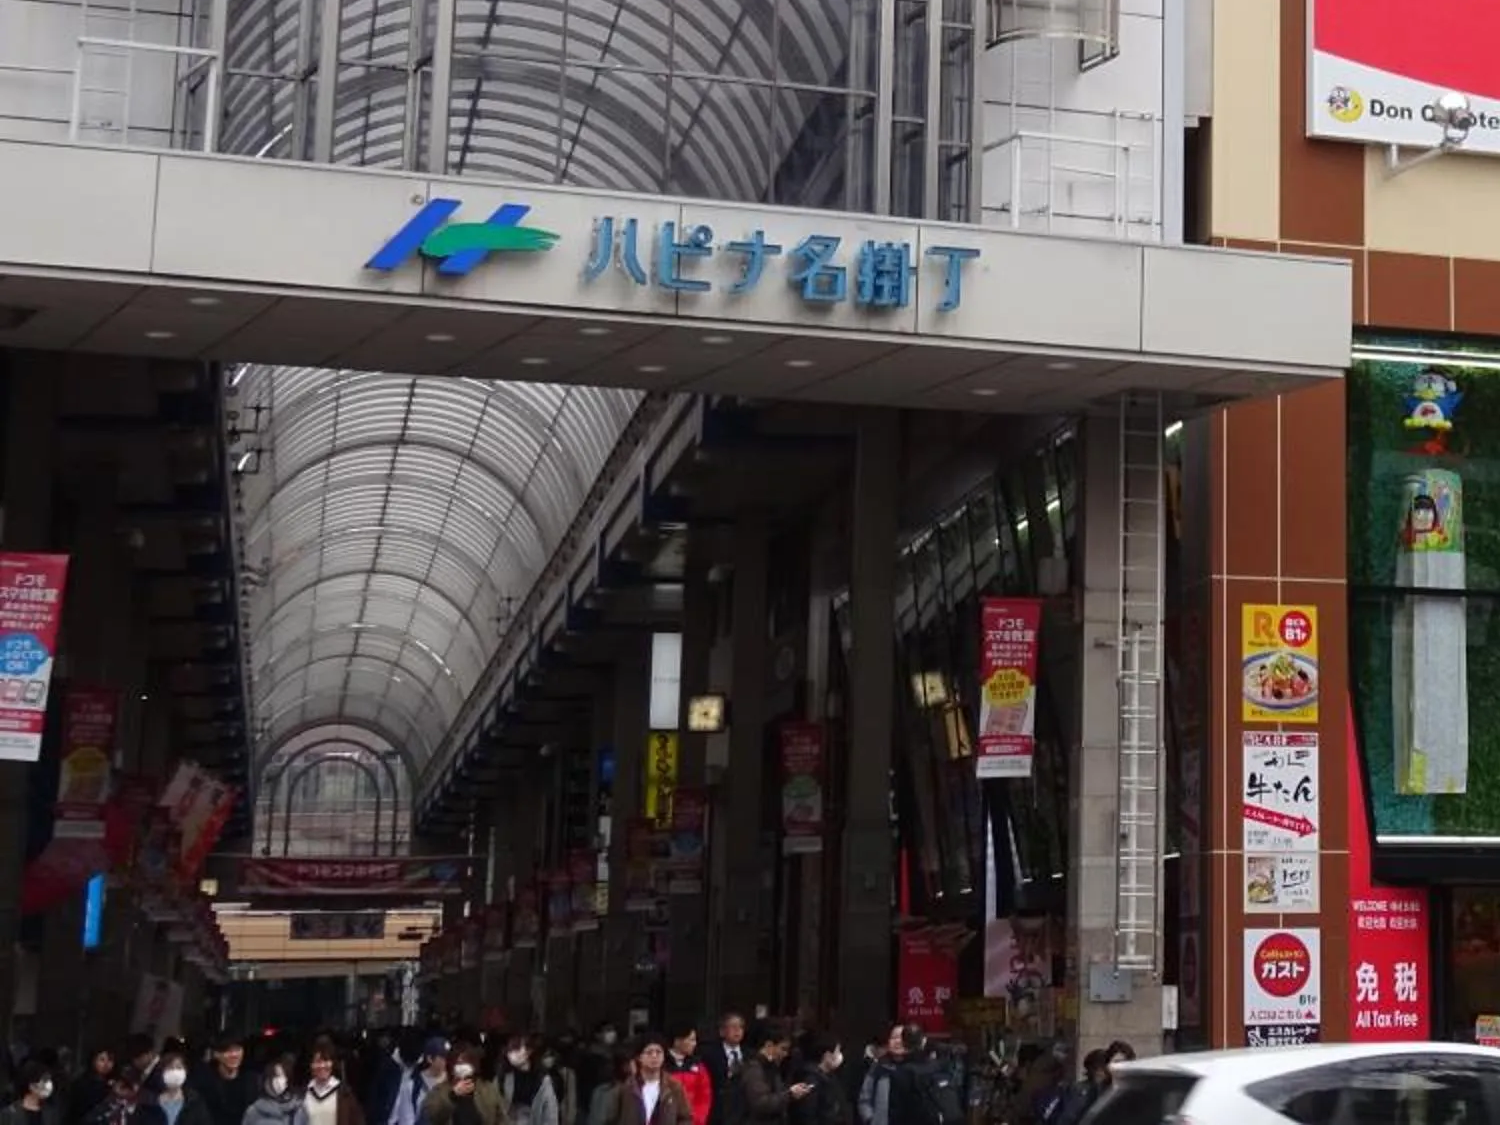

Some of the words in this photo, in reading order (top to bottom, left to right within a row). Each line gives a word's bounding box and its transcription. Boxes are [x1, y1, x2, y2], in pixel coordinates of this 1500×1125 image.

[1370, 99, 1412, 120] Don
[1253, 610, 1276, 639] R
[1246, 772, 1315, 805] 牛たん
[1262, 961, 1305, 980] ガスト
[1356, 961, 1418, 1004] 免税
[1356, 1010, 1371, 1028] All
[1372, 1011, 1393, 1028] Tax
[1394, 1009, 1419, 1027] Free
